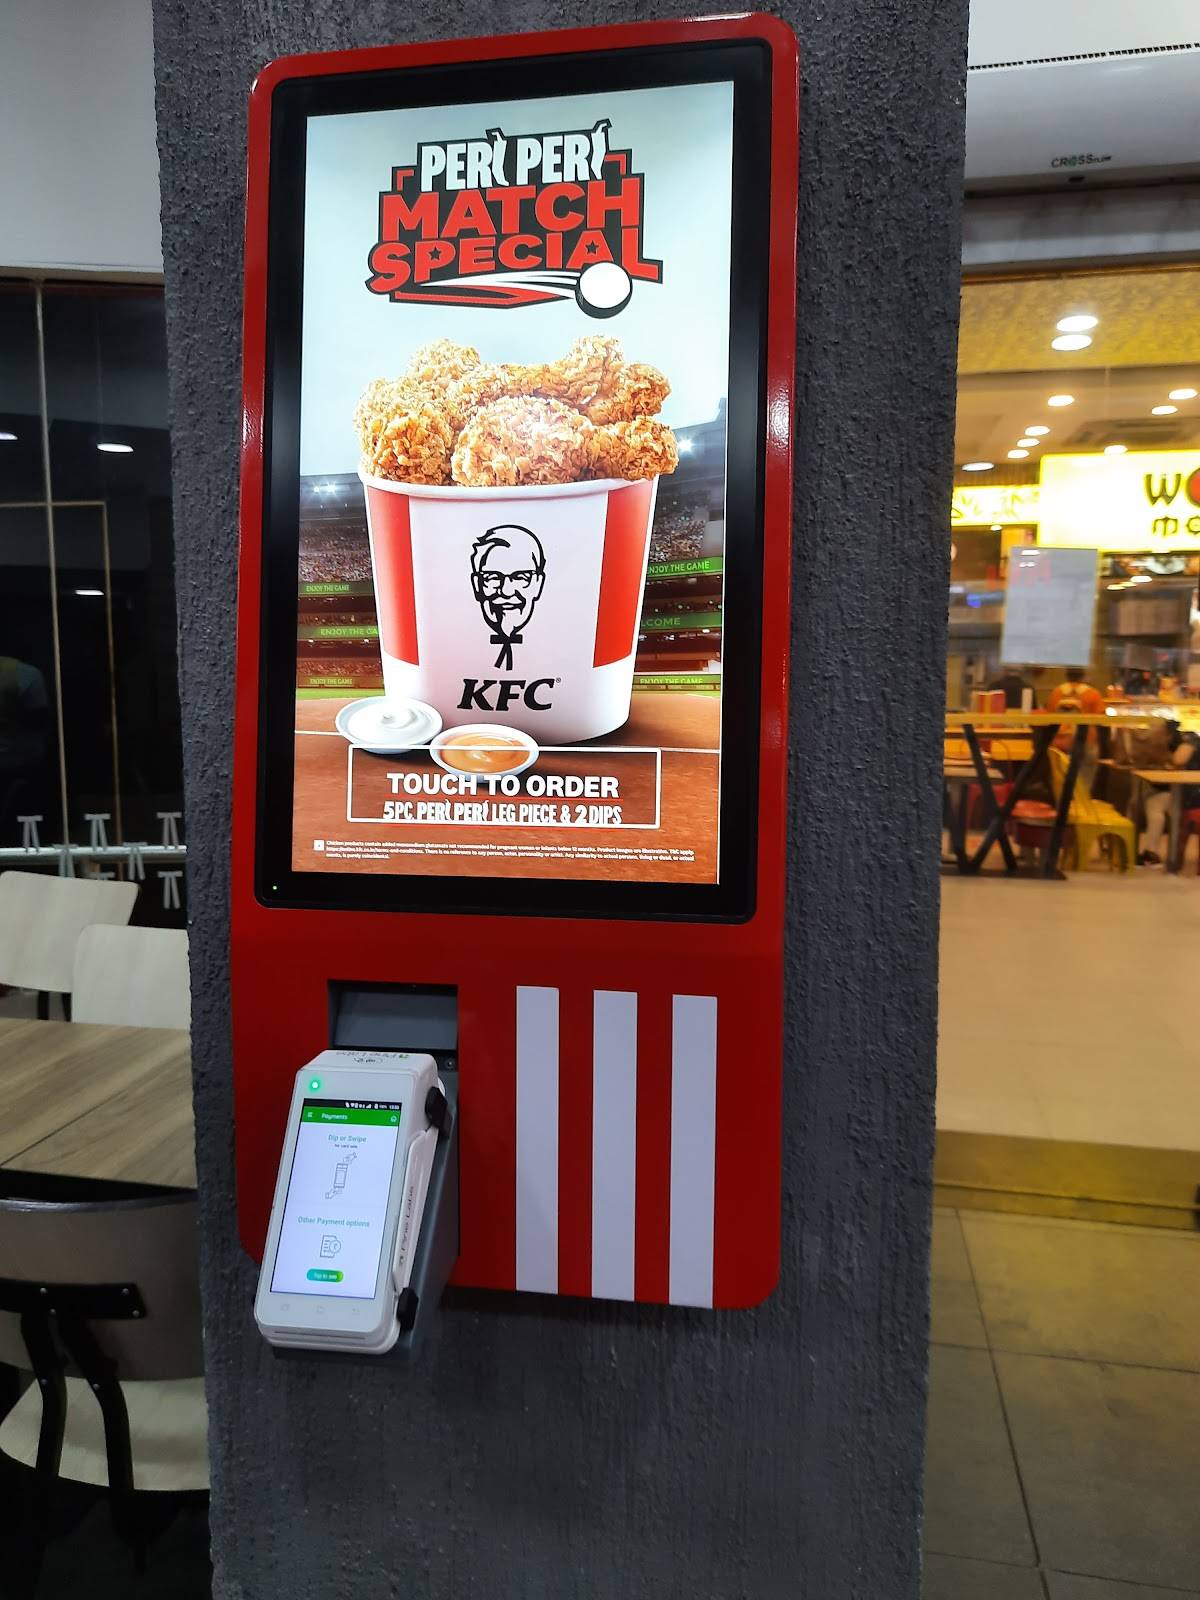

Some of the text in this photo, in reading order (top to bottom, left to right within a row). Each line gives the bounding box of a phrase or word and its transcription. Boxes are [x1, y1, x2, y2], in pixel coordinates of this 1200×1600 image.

[382, 178, 640, 241] MATCH
[368, 228, 659, 293] SPECIAL
[670, 563, 685, 572] THE
[686, 560, 710, 571] GAME
[320, 628, 347, 636] ENJOY
[348, 627, 365, 635] THE
[457, 678, 555, 712] KFC
[386, 772, 620, 798] TOUCH TO ORDER
[491, 803, 517, 823] LEG
[519, 803, 558, 824] PIECE
[559, 804, 573, 824] &
[574, 804, 588, 824] 2
[588, 805, 623, 825] DIPS
[321, 1112, 348, 1121] Payments
[328, 1134, 339, 1142] Dip
[348, 1135, 367, 1143] Swipe
[298, 1216, 315, 1224] Other
[317, 1218, 345, 1226] Payment
